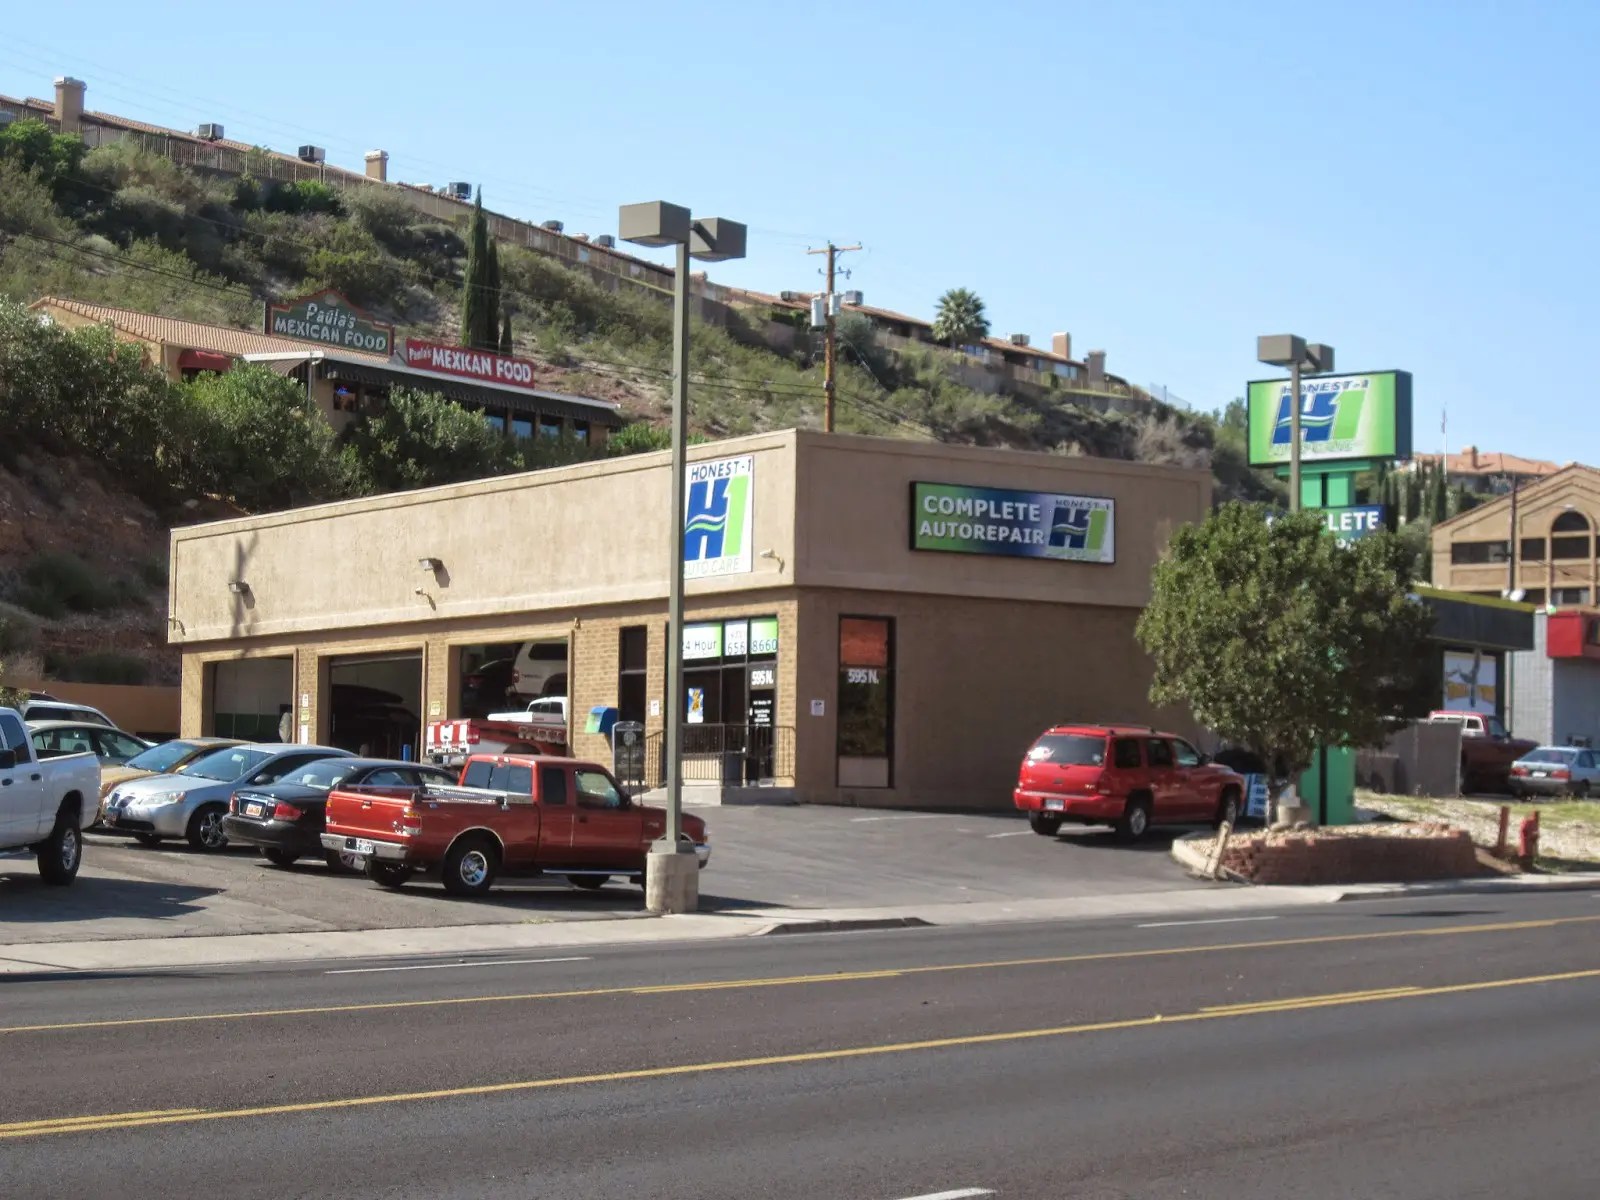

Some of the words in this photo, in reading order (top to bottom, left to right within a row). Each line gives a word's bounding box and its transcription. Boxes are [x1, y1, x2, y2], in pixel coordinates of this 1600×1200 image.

[306, 303, 357, 329] Paula's
[274, 316, 340, 344] MEXICAN
[344, 331, 387, 351] FOOD
[432, 347, 492, 375] MEXICAN
[496, 359, 532, 383] FOOD
[924, 495, 1040, 522] COMPLETE
[919, 520, 1044, 544] AUTOREPAIR
